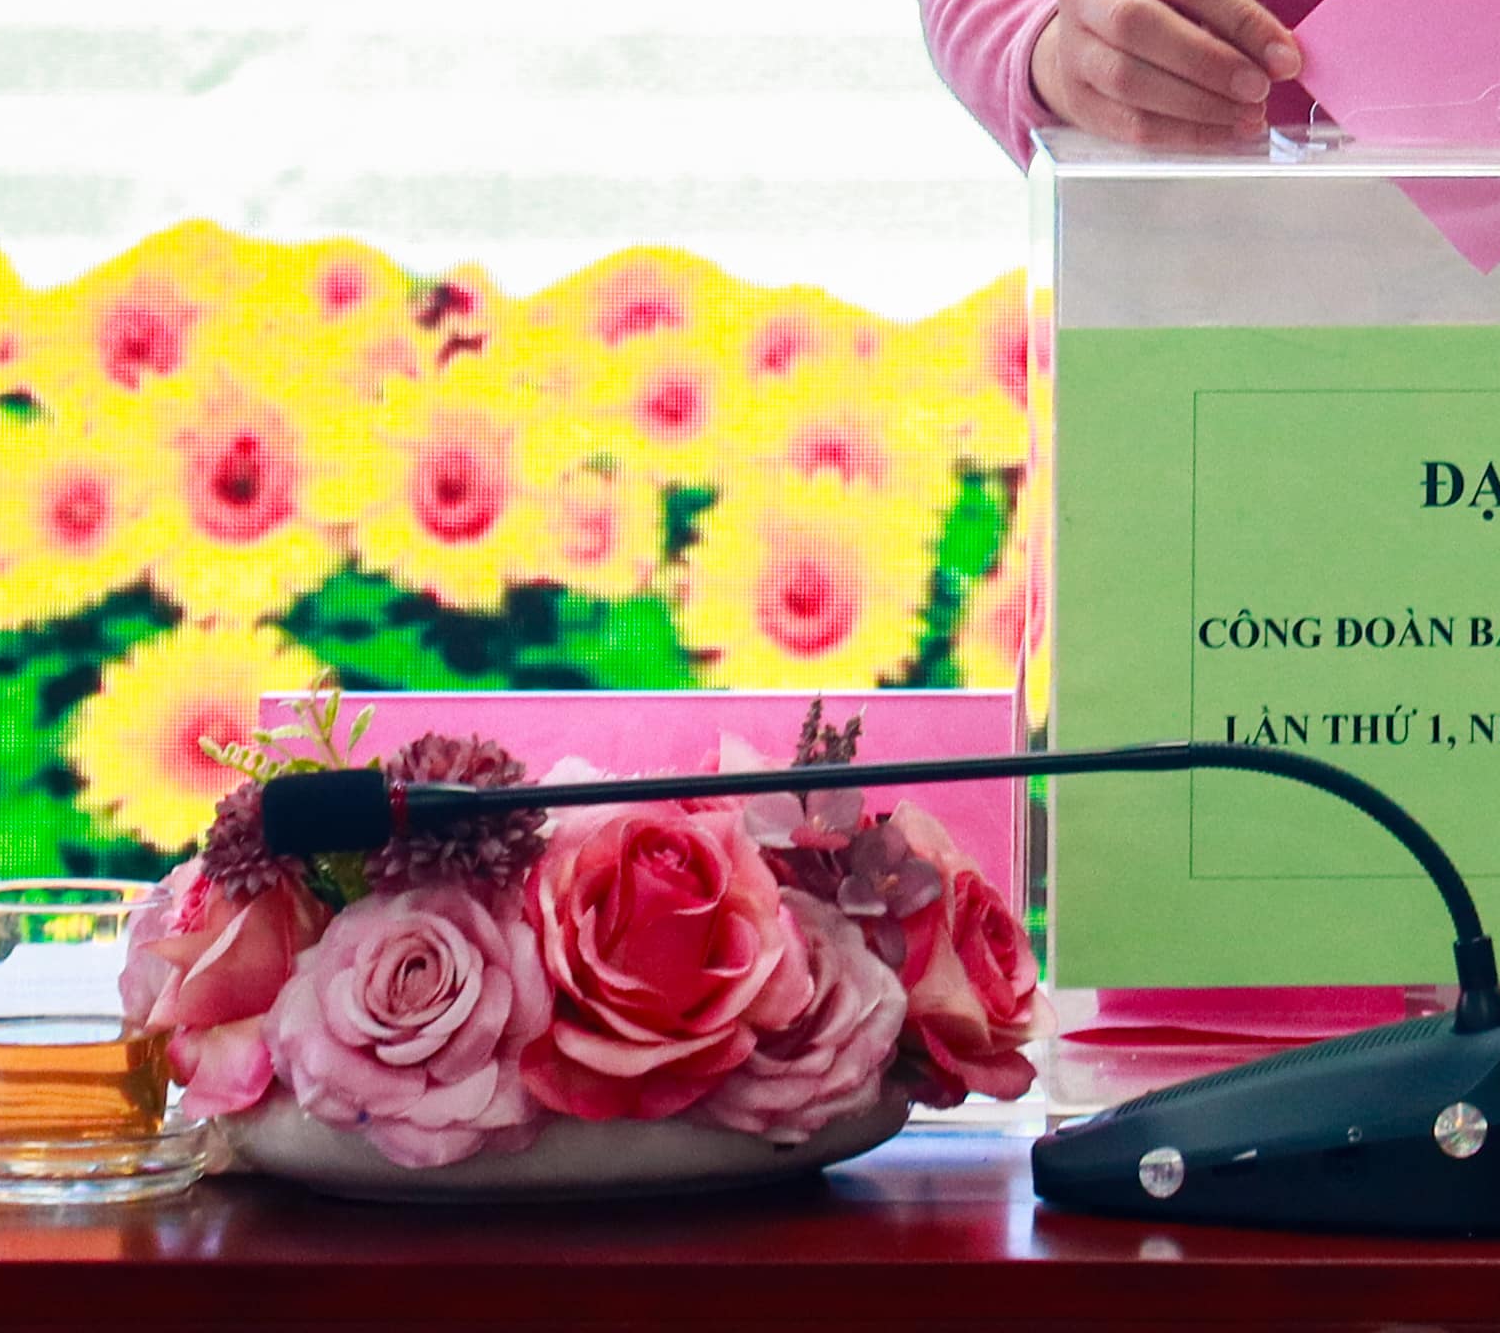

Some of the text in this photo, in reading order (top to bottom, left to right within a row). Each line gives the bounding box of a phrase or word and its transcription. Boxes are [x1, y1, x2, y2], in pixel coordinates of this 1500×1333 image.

[1198, 608, 1323, 650] CÔNG
[1335, 609, 1456, 649] ĐOÀN
[1322, 704, 1416, 746] THỨ
[1428, 712, 1457, 751] 1,
